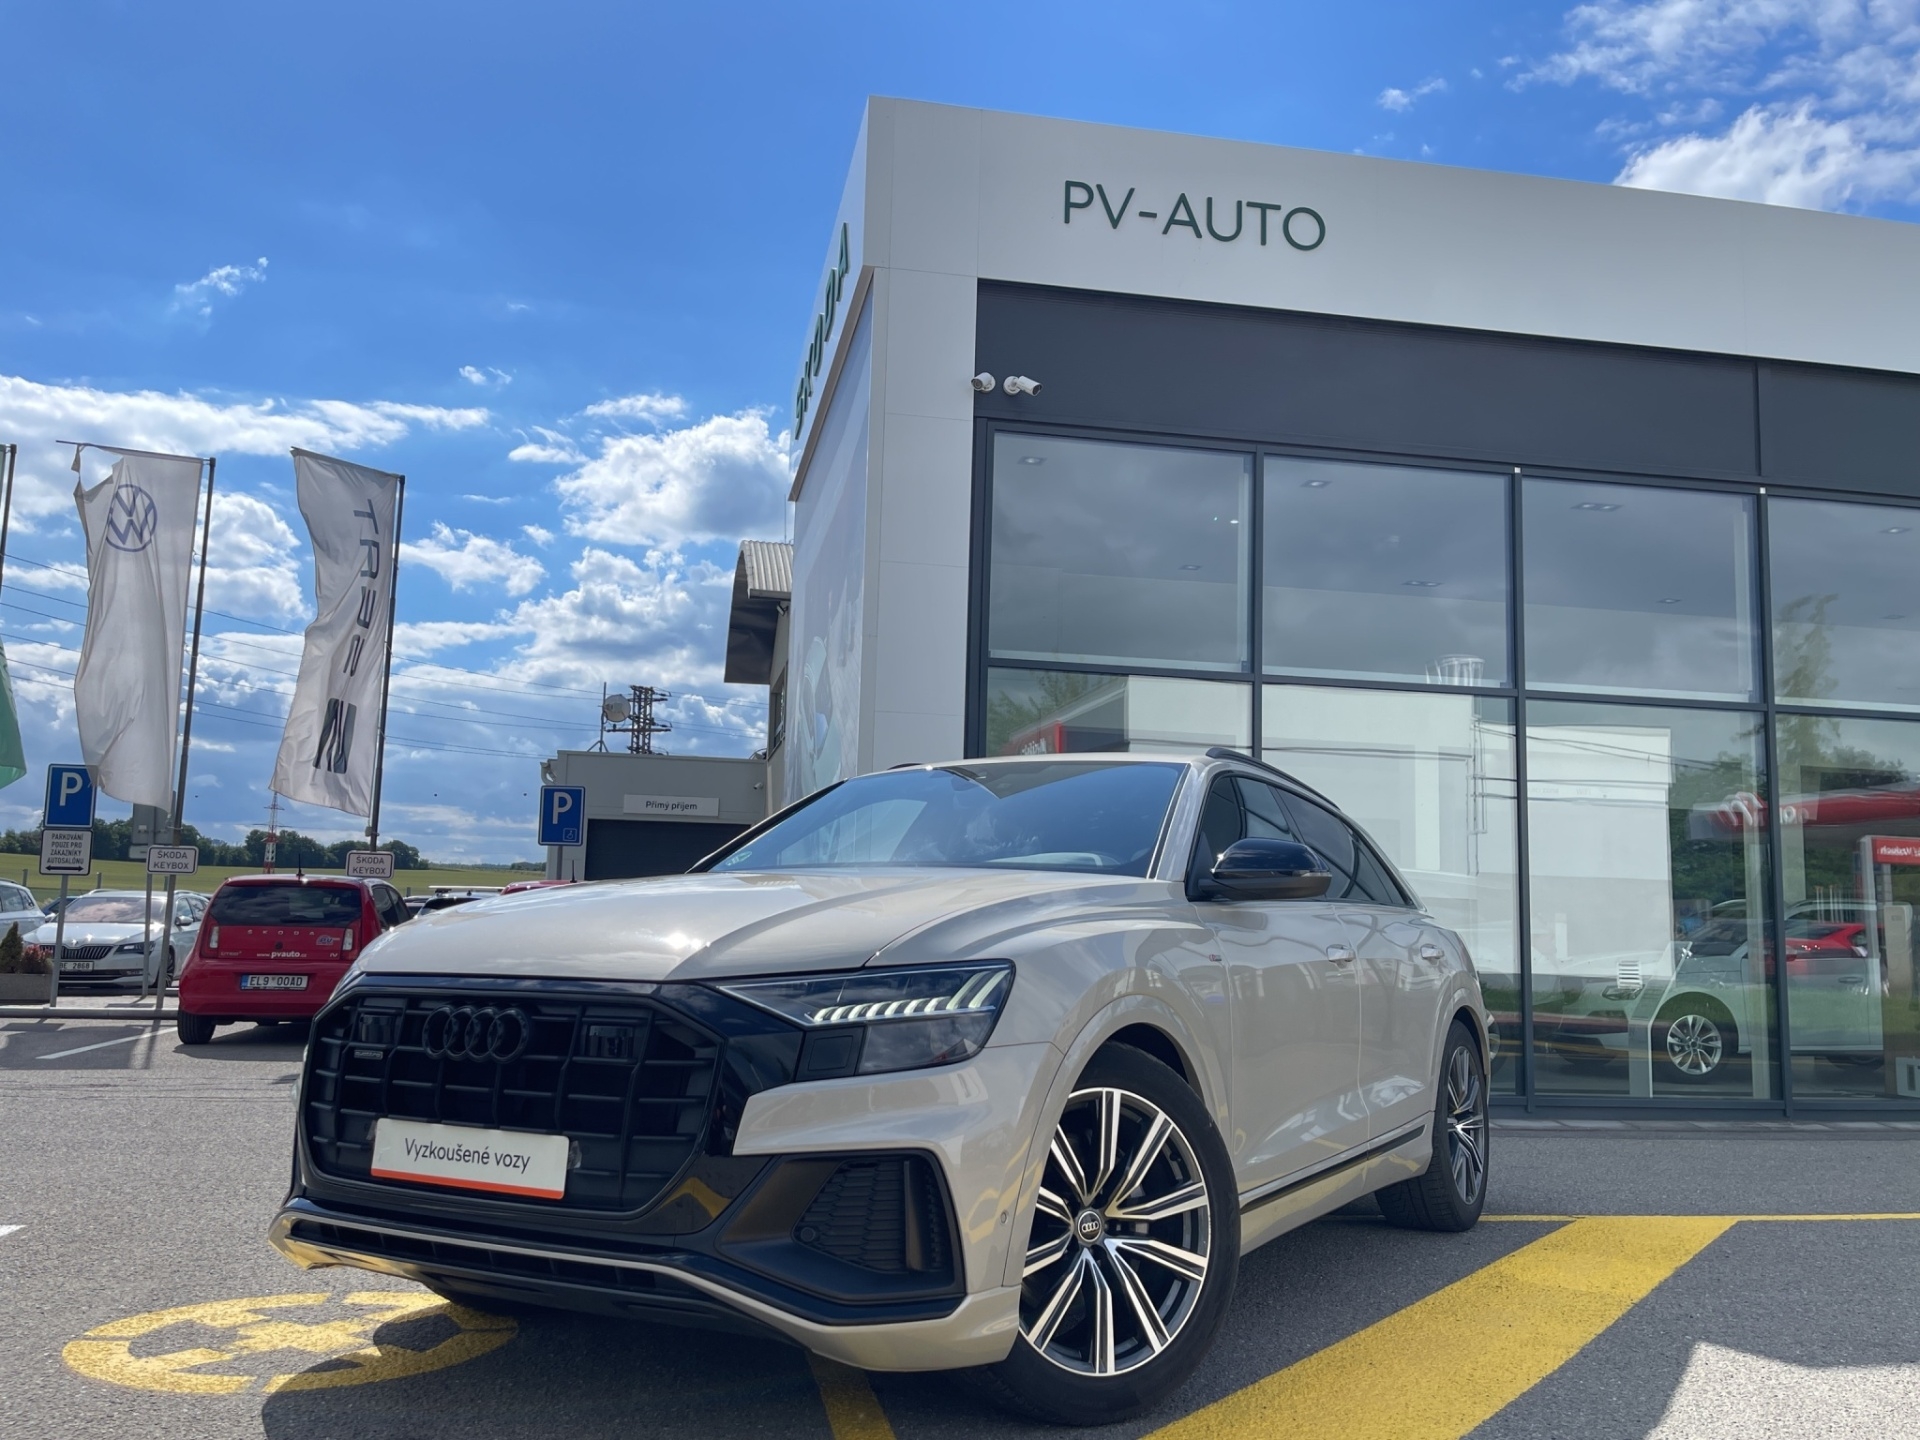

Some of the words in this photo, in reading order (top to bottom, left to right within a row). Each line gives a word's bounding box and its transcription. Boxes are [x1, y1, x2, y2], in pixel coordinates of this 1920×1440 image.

[1064, 180, 1326, 251] PV-AUTO
[59, 772, 84, 806] P
[552, 791, 573, 825] P
[51, 832, 84, 841] PARKOVÁNÍ
[51, 841, 70, 849] POUZE
[50, 849, 82, 857] ZÁKAZNÍKY
[157, 850, 188, 860] ŠKODA
[46, 857, 85, 865] AUTOSALÓNU
[356, 855, 385, 865] ŠKODA
[153, 861, 190, 870] KEYBOX
[352, 866, 386, 875] KEYBOX
[249, 976, 269, 986] EL9
[405, 1137, 490, 1165] Vyzkoušené
[494, 1151, 531, 1175] vozy
